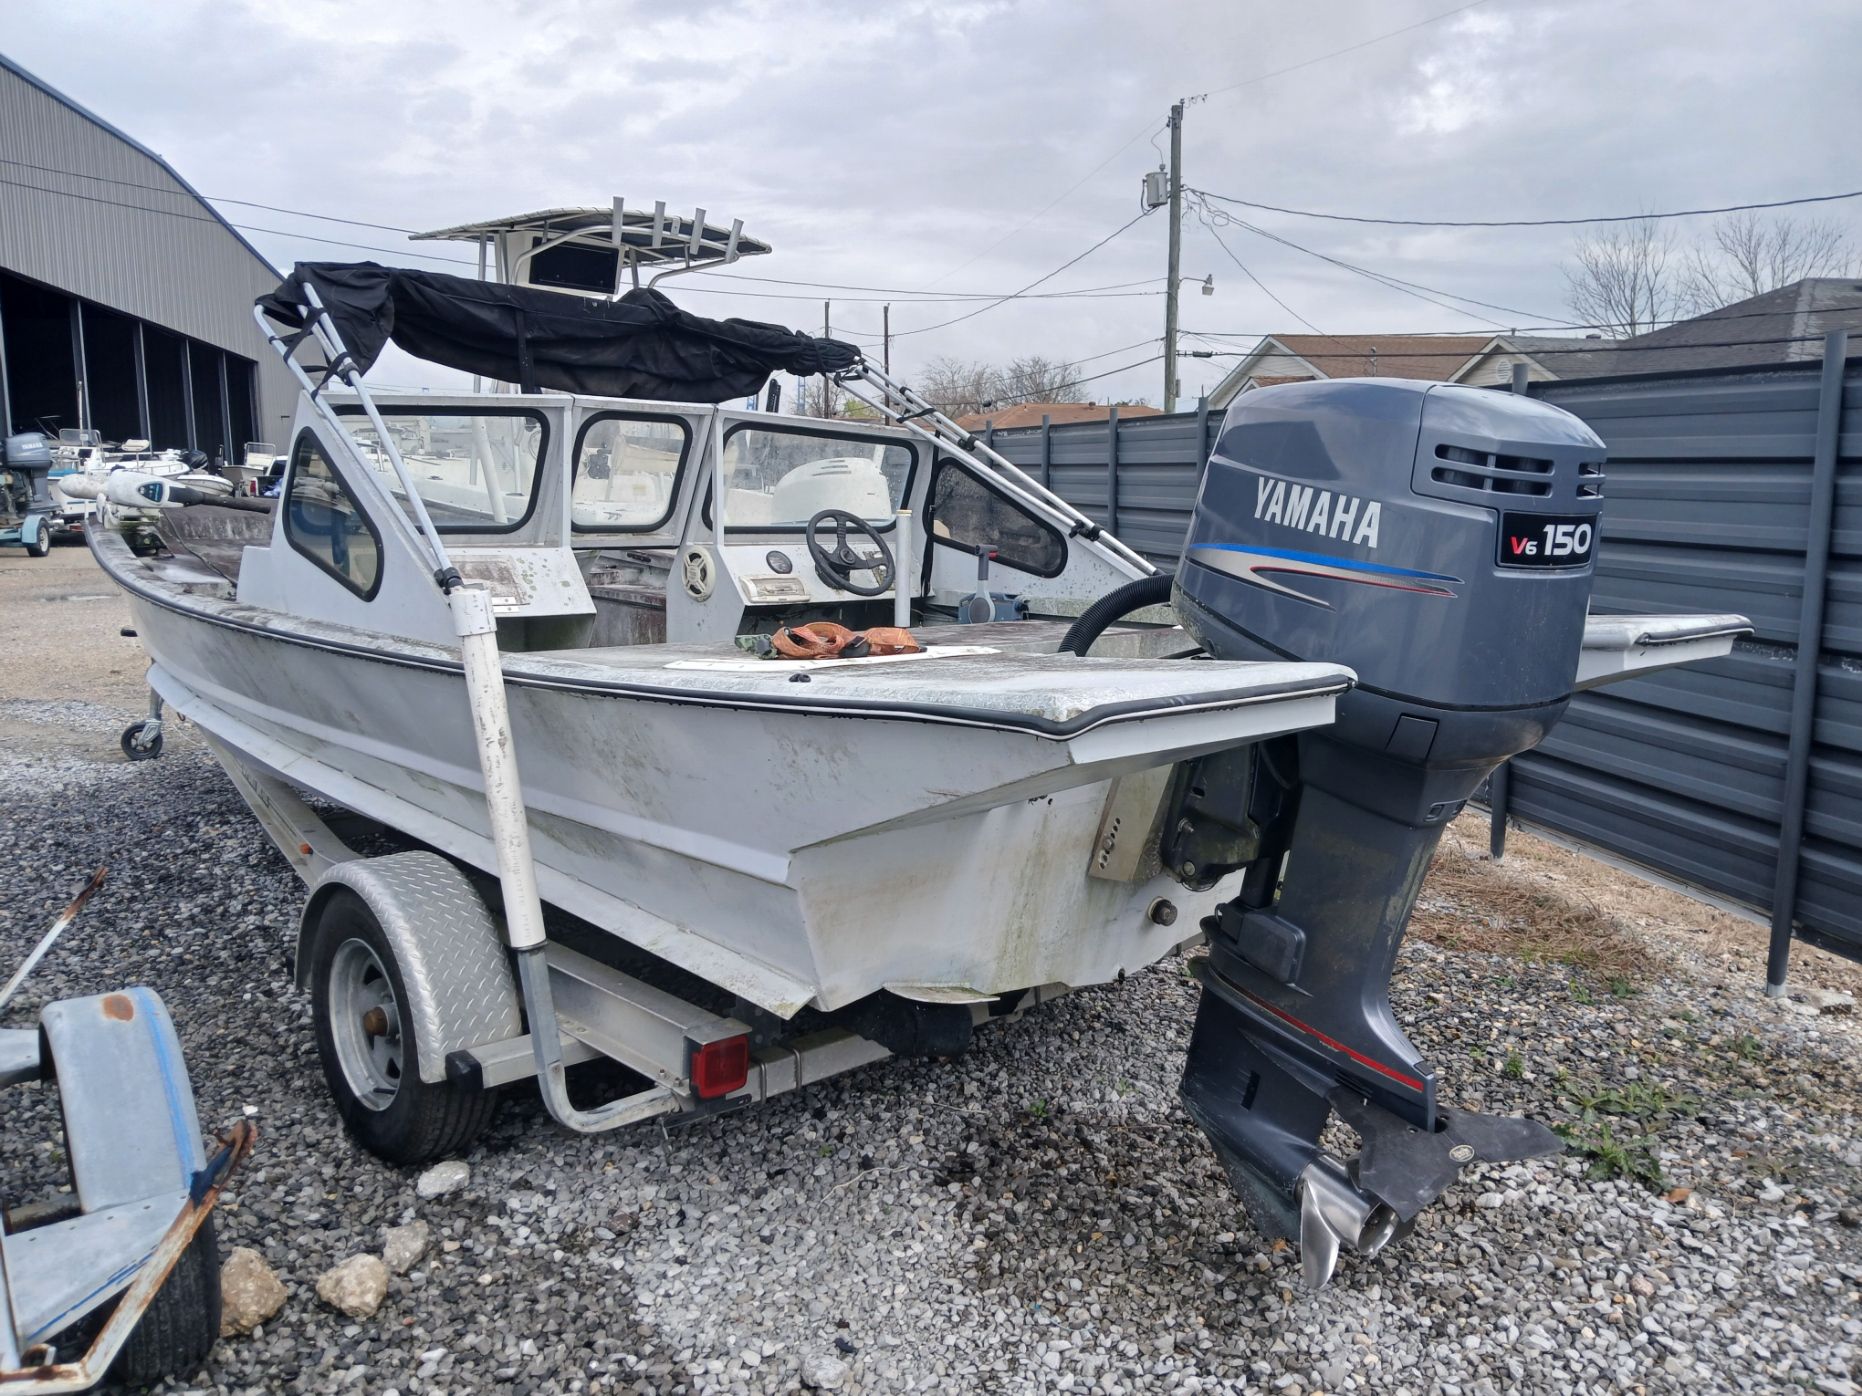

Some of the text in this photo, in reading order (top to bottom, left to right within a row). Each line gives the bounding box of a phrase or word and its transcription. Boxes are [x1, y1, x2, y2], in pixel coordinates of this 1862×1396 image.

[1254, 476, 1382, 549] YAMAHA
[1510, 523, 1592, 556] V6 150
